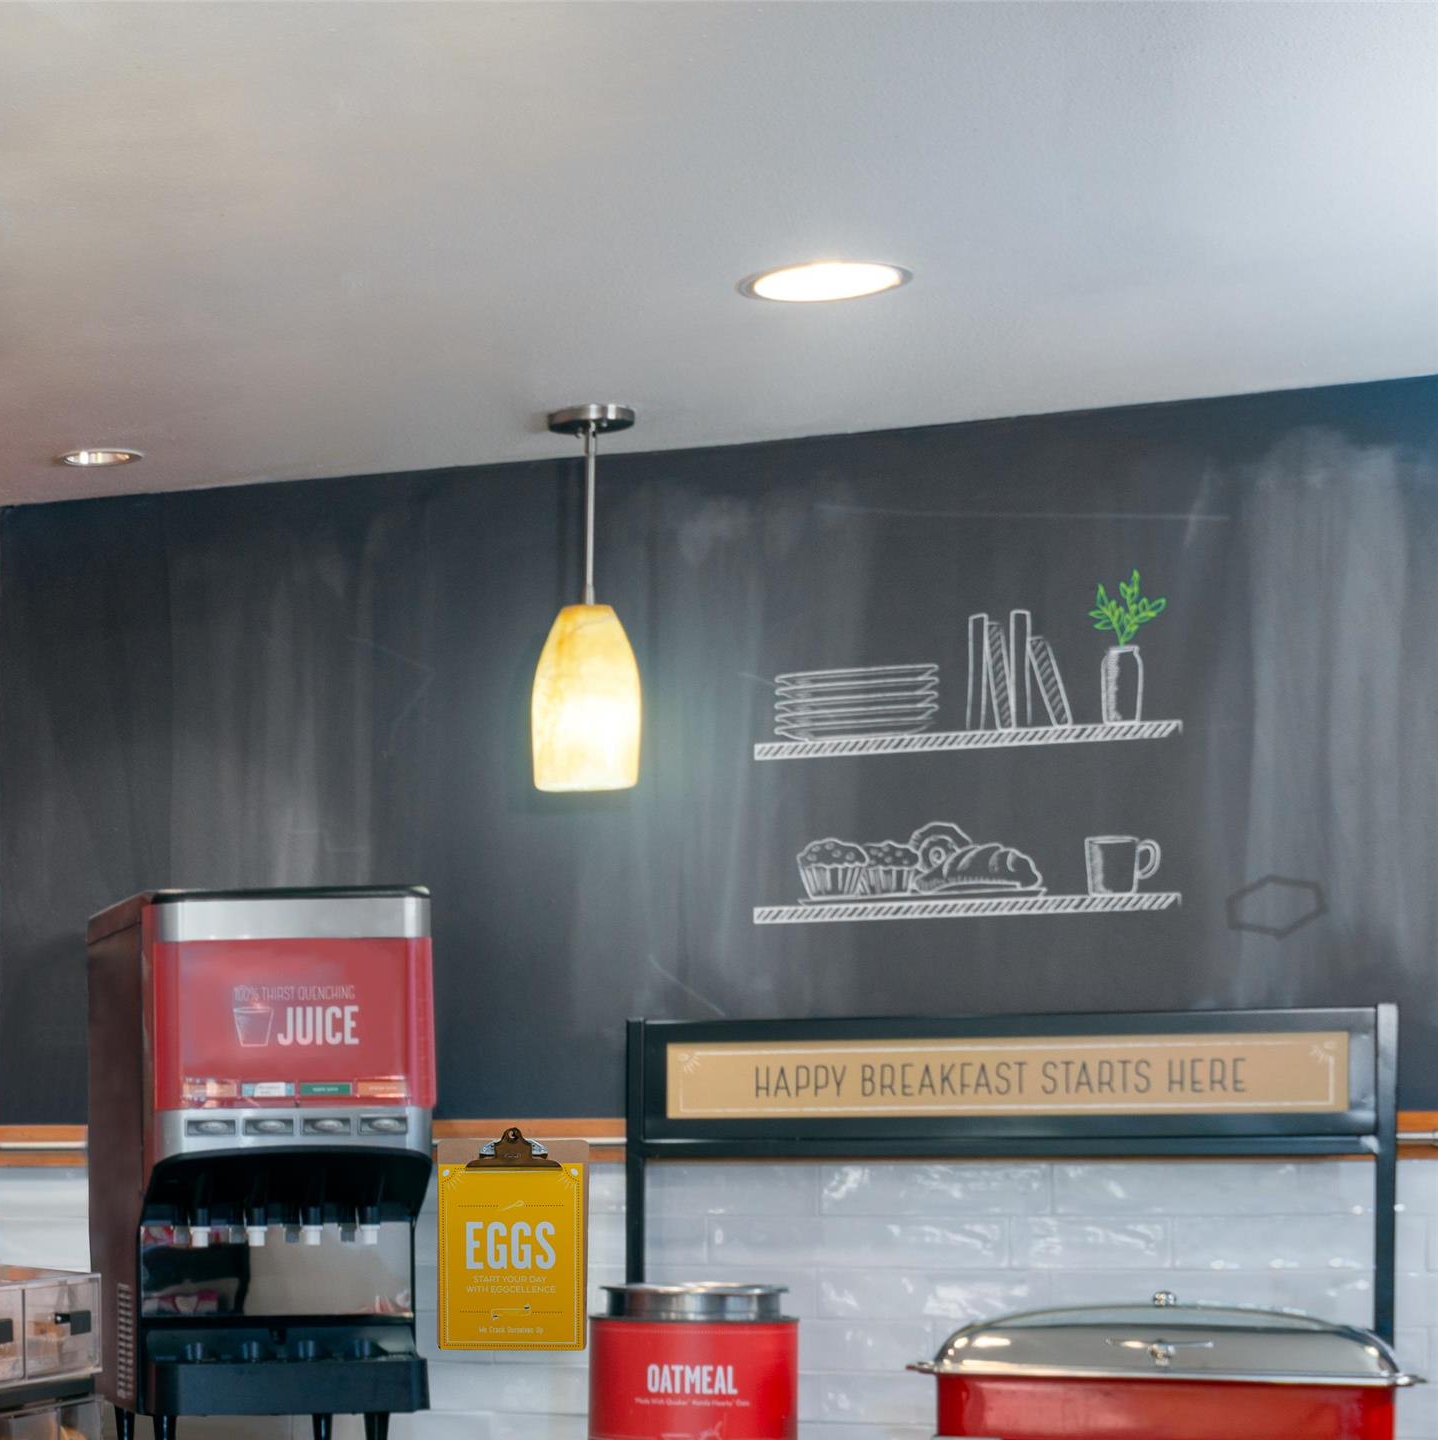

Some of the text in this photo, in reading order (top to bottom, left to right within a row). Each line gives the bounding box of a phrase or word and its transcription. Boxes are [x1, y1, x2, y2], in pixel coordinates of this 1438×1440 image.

[262, 985, 295, 1000] THIRST
[298, 985, 356, 1000] QUENCHING
[277, 1005, 360, 1046] JUICE
[755, 1057, 1247, 1098] HAPPY BREAKFAST STARTS HERE
[465, 1221, 557, 1270] EGGS
[467, 1285, 489, 1294] WITH
[473, 1275, 547, 1283] START YOUR DAY
[647, 1364, 739, 1395] OATMEAL
